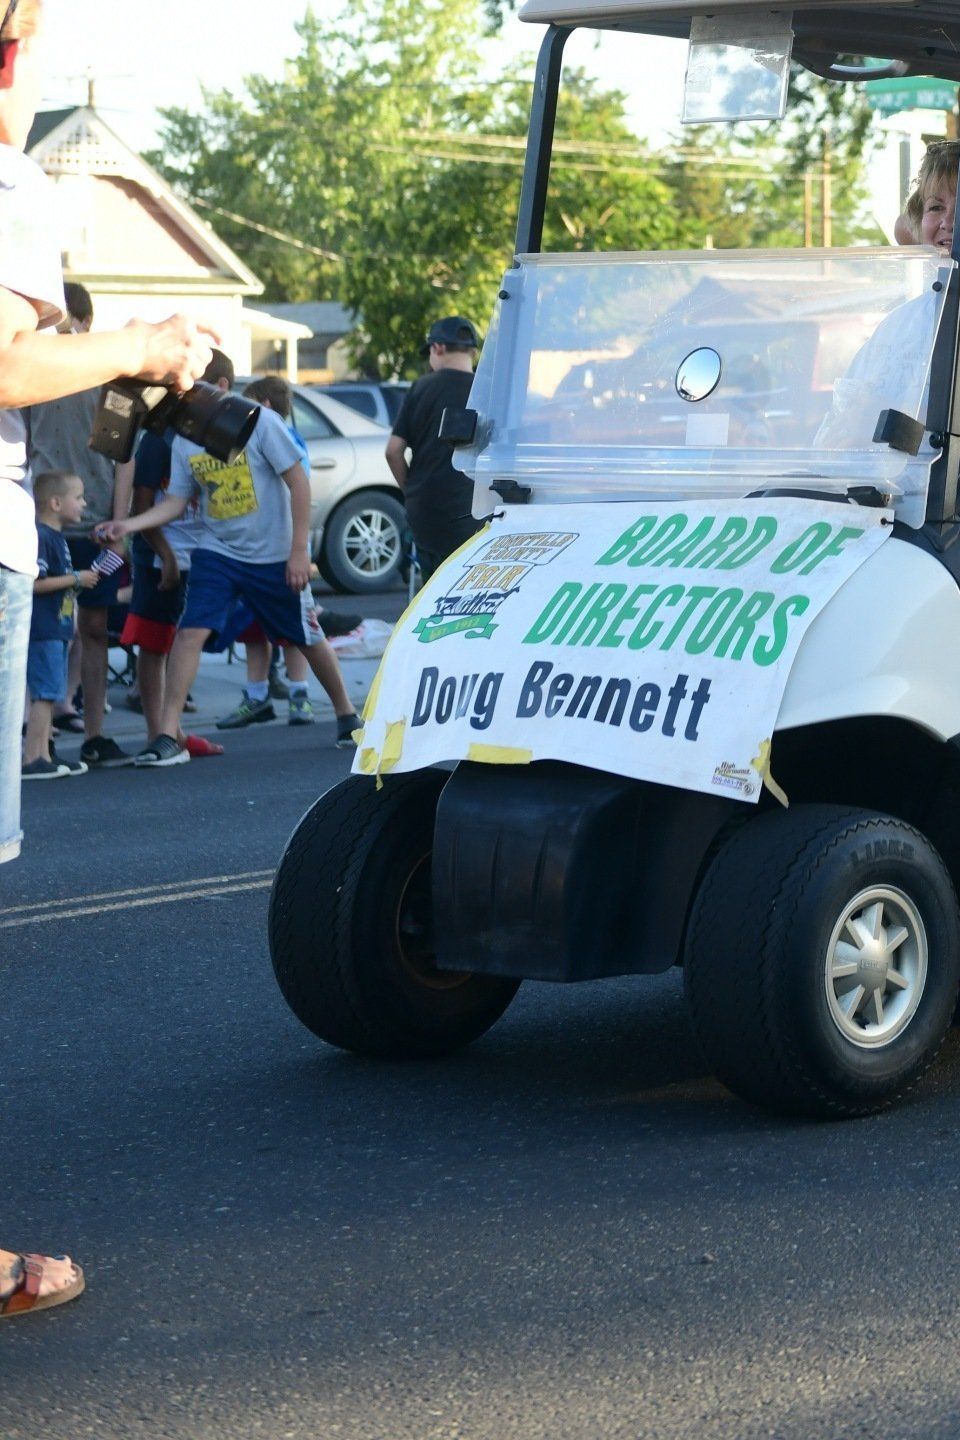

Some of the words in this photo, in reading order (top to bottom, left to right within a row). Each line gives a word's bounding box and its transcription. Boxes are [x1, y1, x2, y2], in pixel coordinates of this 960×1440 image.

[481, 547, 554, 561] COUNTY
[594, 515, 780, 572] BOARD
[772, 521, 865, 576] OF
[456, 564, 528, 592] FAIR
[521, 581, 811, 667] DIRECTORS
[411, 666, 505, 731] Doug
[515, 660, 712, 742] Bennett
